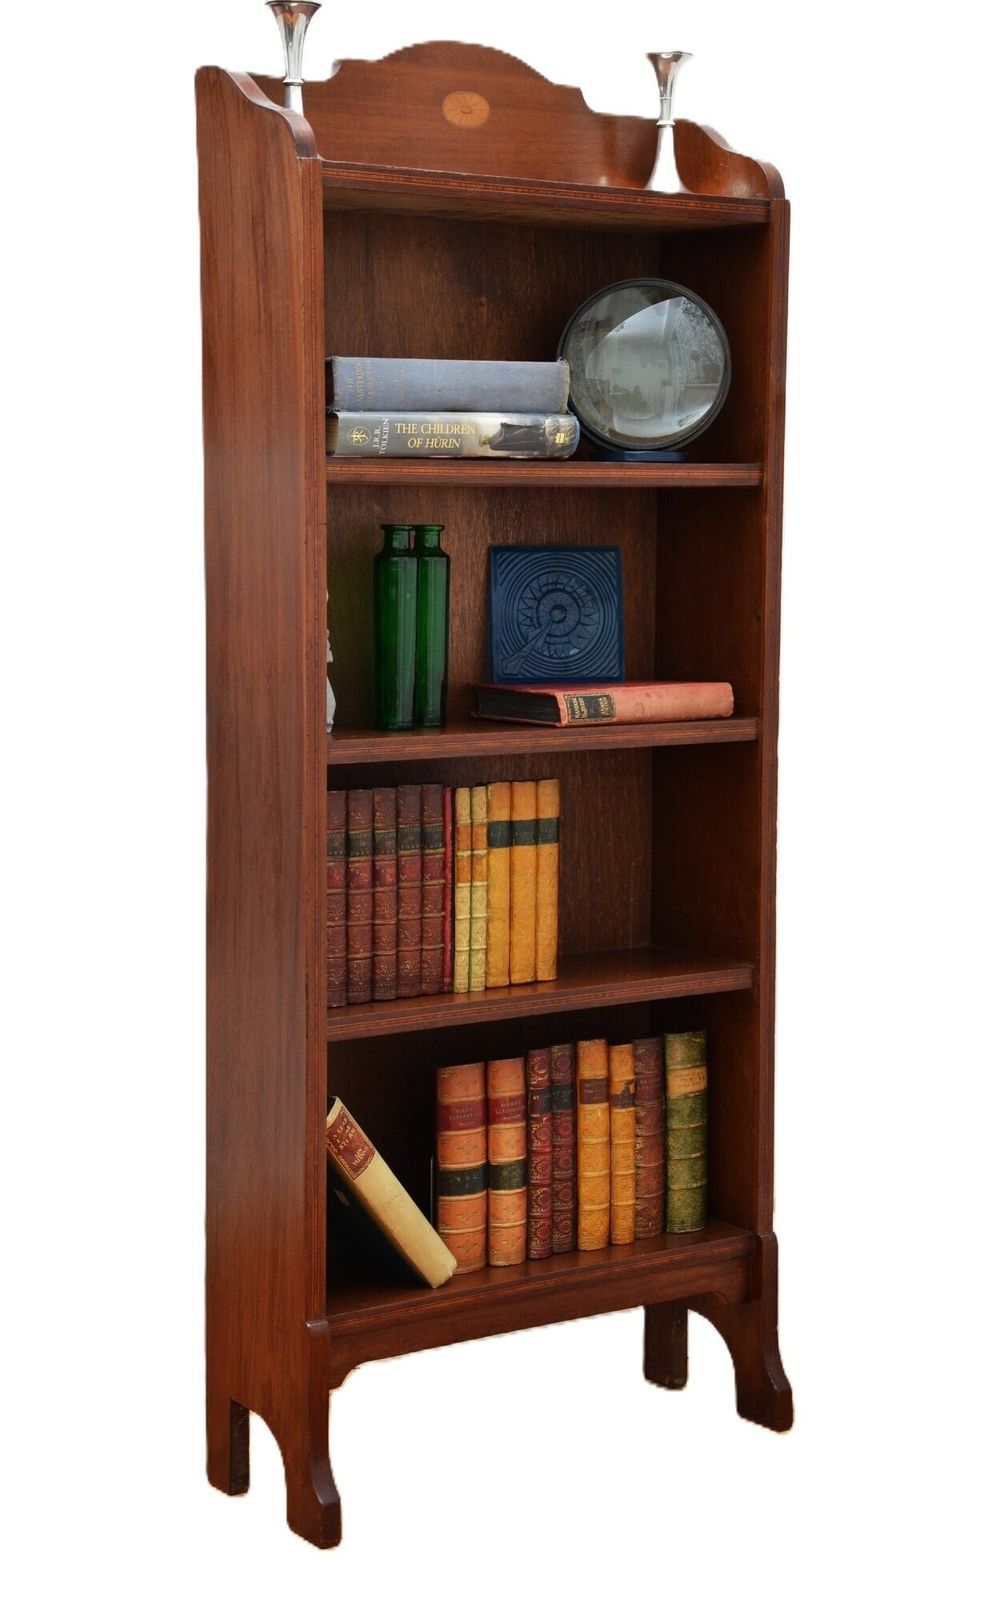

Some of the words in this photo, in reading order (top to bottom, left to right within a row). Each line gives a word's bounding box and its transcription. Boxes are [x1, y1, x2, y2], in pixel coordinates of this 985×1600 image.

[372, 426, 381, 449] J.R.R.
[379, 417, 390, 455] TOLKIEN
[395, 424, 417, 435] THE
[420, 422, 476, 435] CHILDREN
[407, 438, 422, 449] OF
[425, 434, 461, 449] HÚRIN
